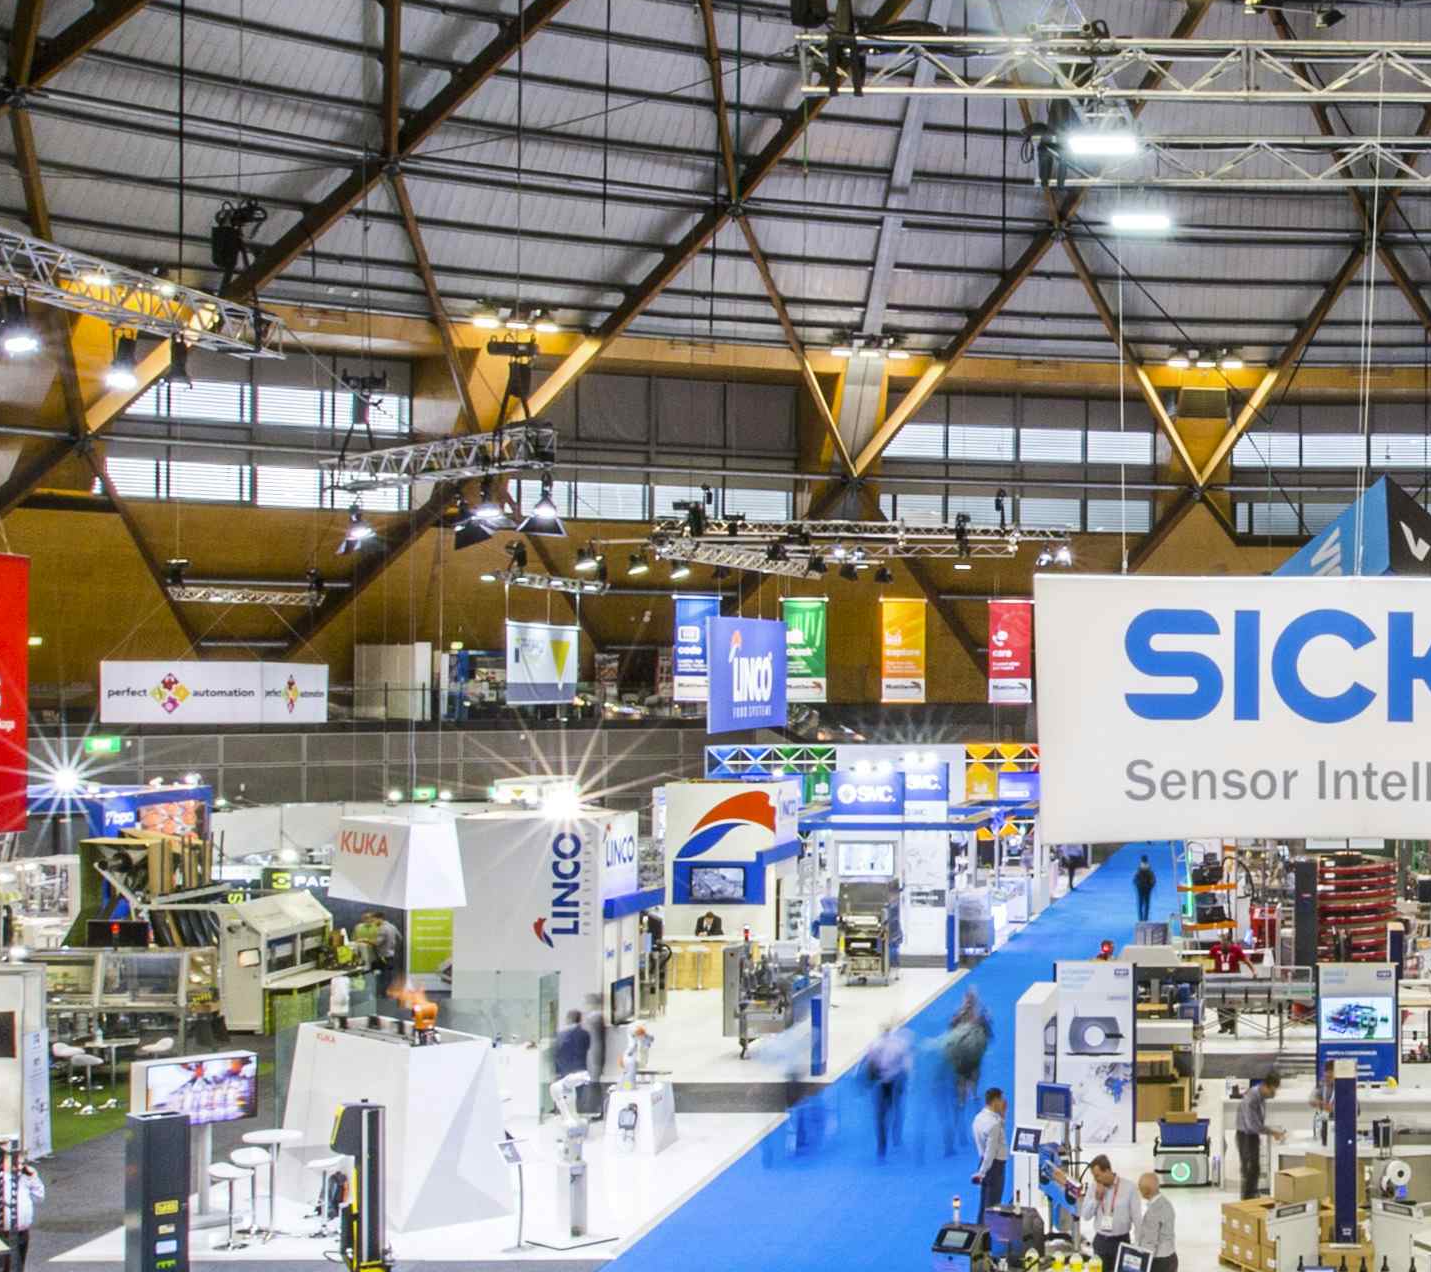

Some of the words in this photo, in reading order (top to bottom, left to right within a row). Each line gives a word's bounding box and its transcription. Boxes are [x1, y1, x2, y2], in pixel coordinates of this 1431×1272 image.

[107, 687, 148, 700] perfect
[193, 687, 255, 699] automation
[732, 654, 773, 703] LINCO
[1124, 759, 1298, 804] Sensor
[340, 830, 390, 859] KUKA
[606, 835, 634, 868] LINCO
[551, 832, 582, 936] LINCO
